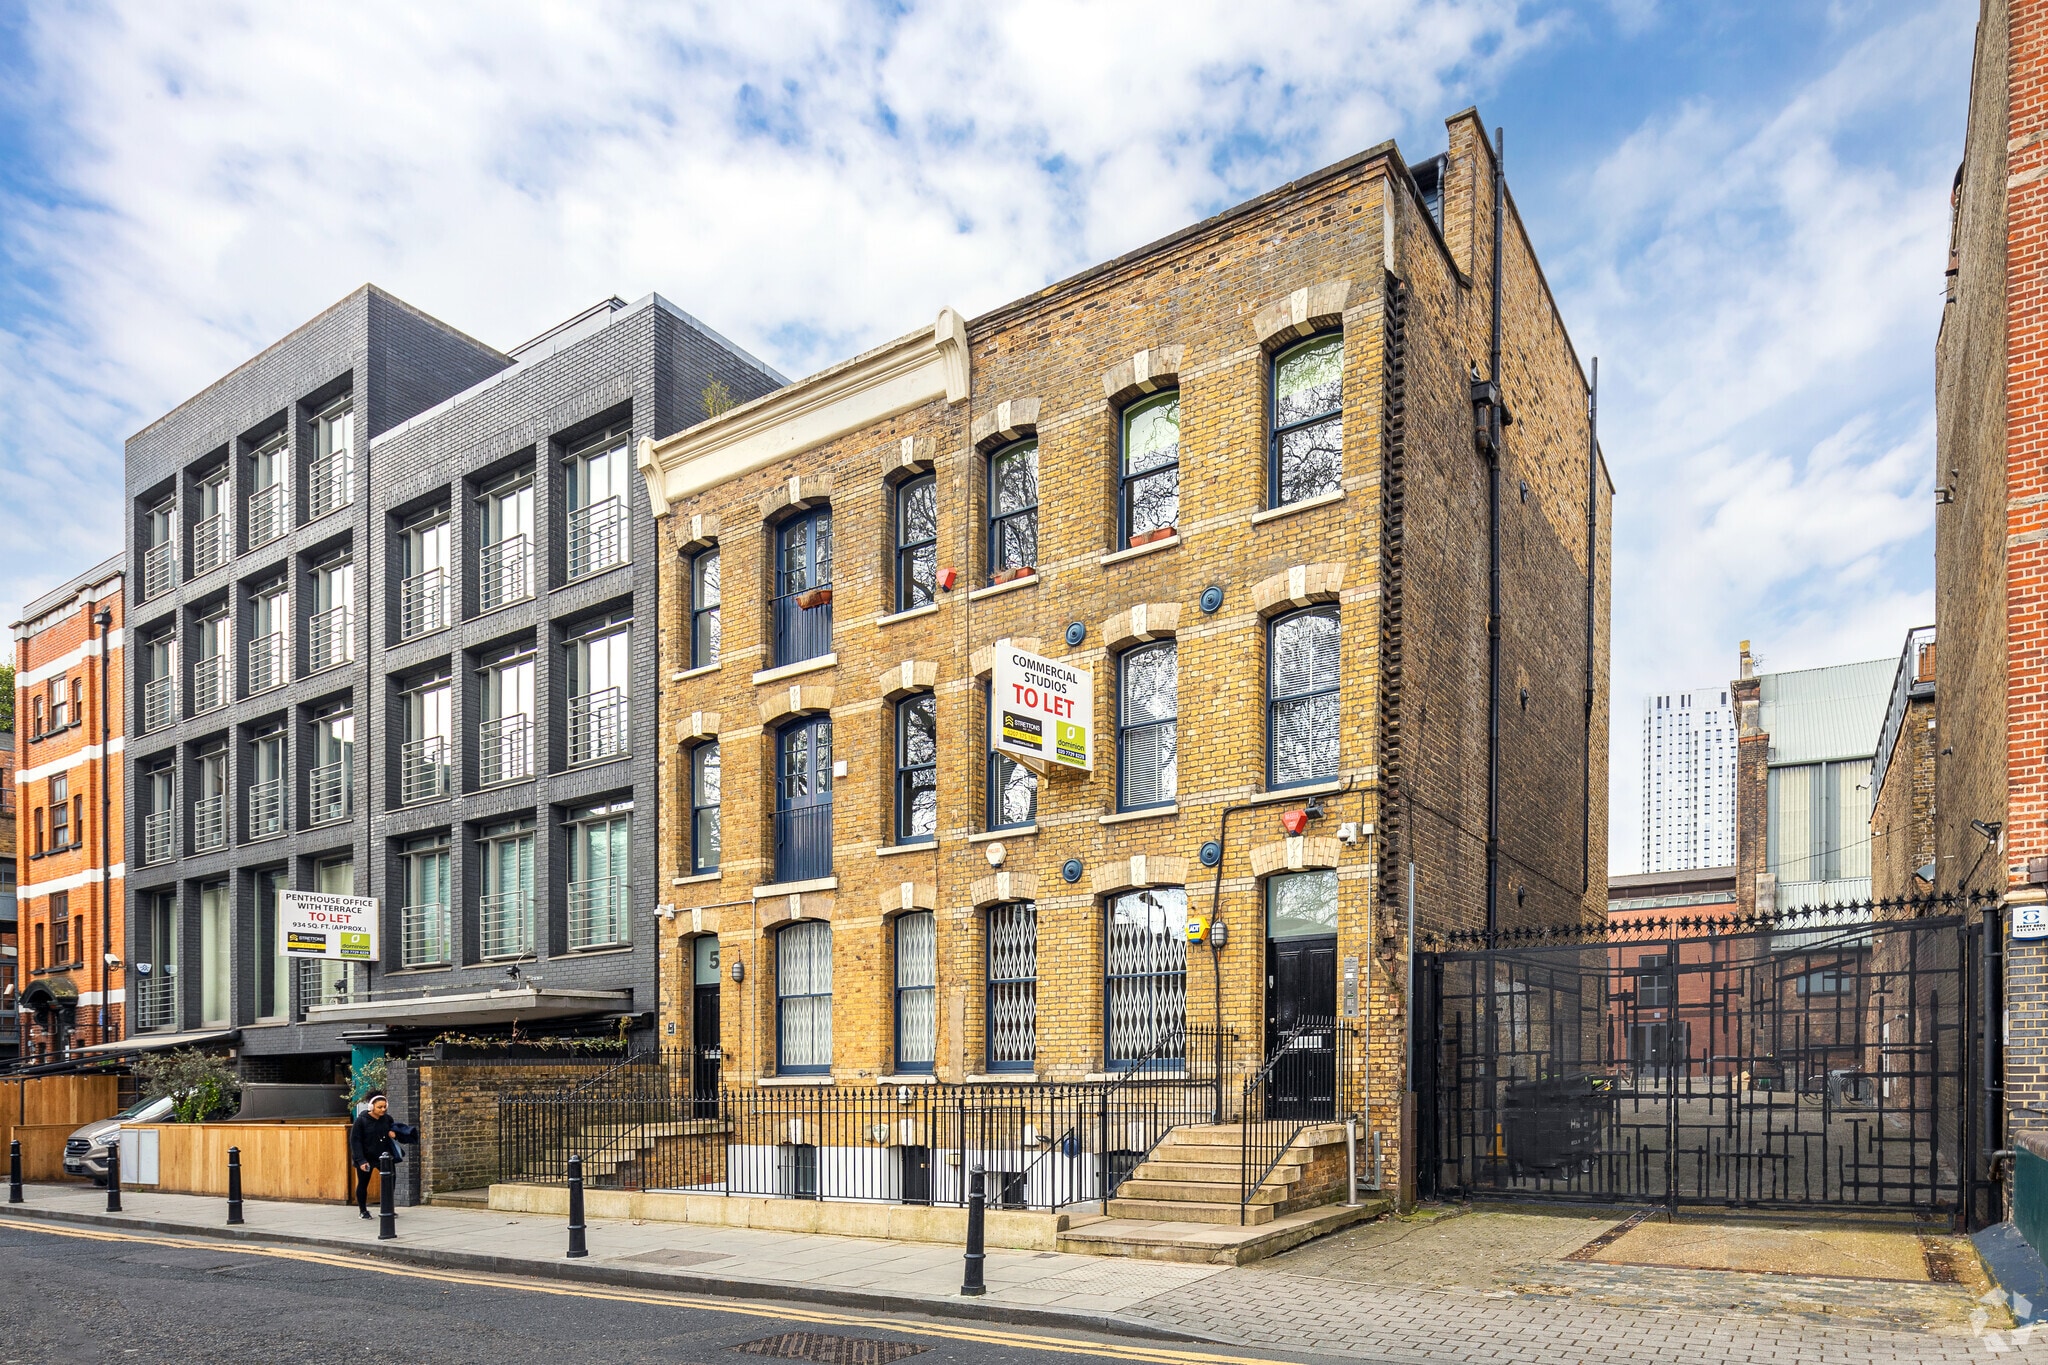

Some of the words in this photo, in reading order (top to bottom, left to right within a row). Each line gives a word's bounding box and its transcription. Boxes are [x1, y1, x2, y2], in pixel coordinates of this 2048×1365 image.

[1012, 654, 1078, 684] COMMERCIAL
[1024, 672, 1067, 693] STUDIOS
[1012, 683, 1038, 708] TO
[1044, 692, 1074, 718] LET
[1014, 719, 1040, 732] STRETTONS
[1058, 739, 1084, 751] dominion
[286, 894, 340, 904] PENTHOUSE
[343, 898, 373, 907] OFFICE
[298, 903, 321, 911] WITH
[324, 904, 362, 914] TERRACE
[309, 912, 326, 922] TO
[330, 914, 352, 923] LET
[709, 951, 720, 969] 5
